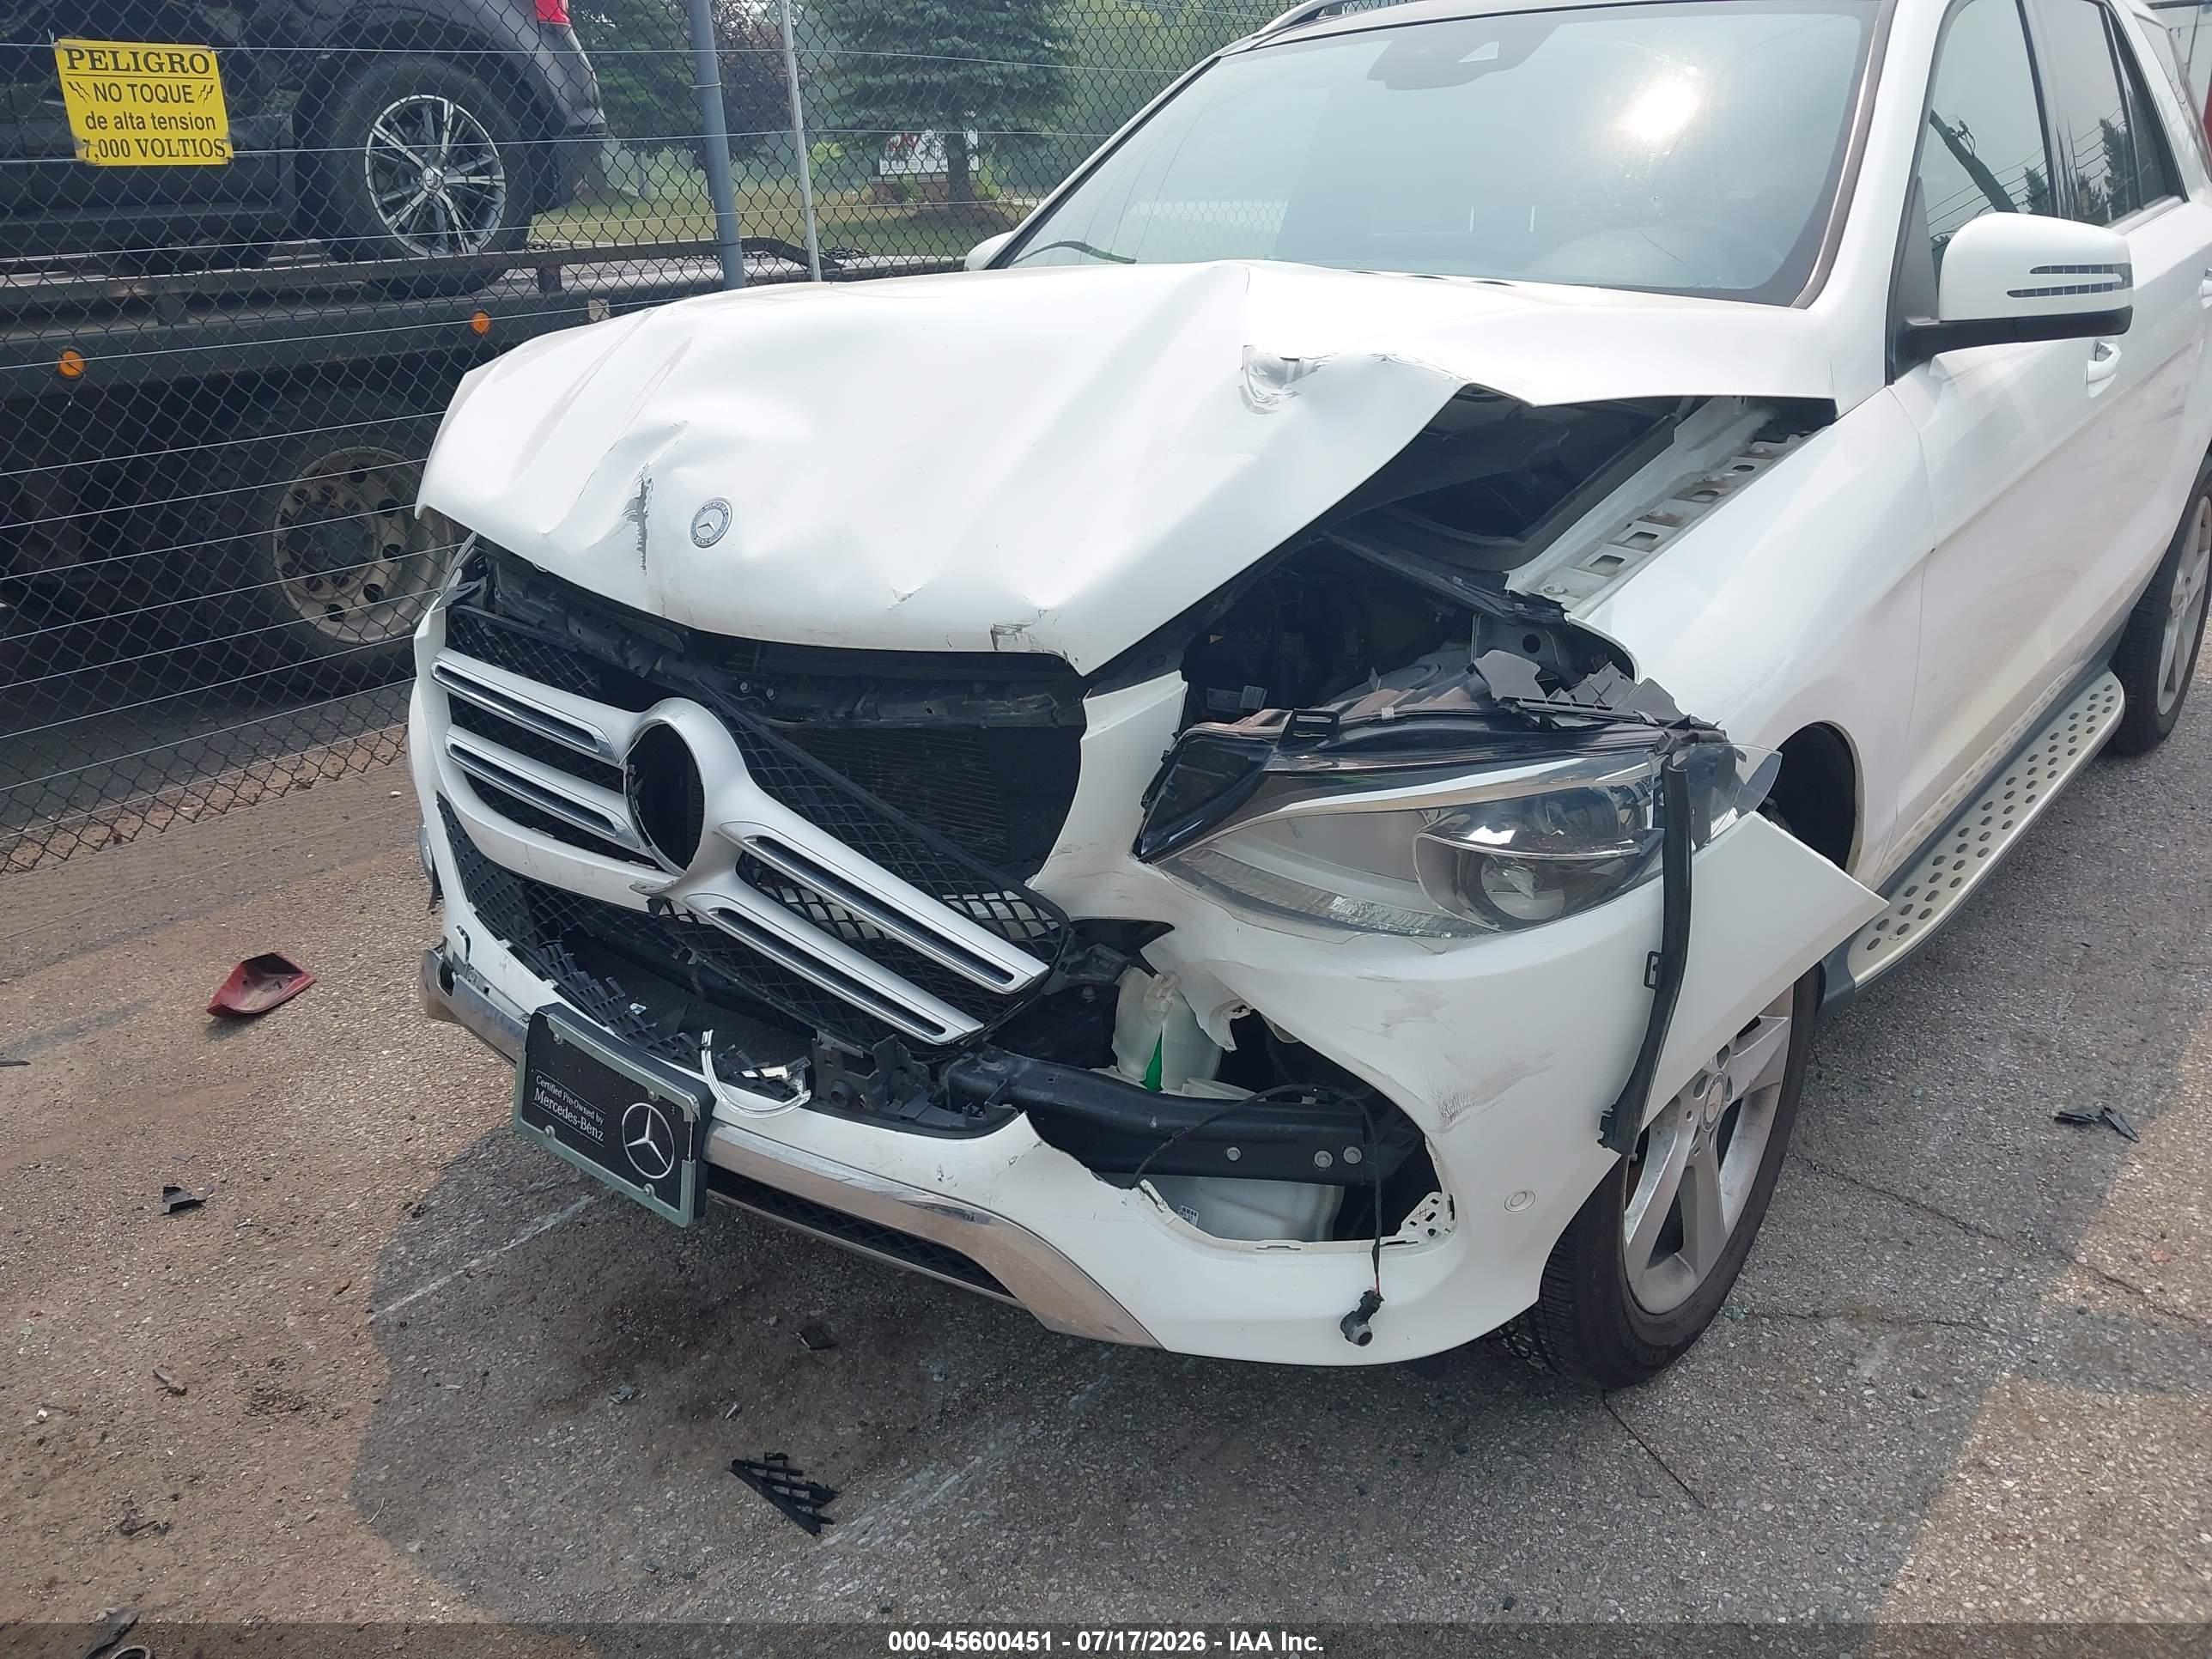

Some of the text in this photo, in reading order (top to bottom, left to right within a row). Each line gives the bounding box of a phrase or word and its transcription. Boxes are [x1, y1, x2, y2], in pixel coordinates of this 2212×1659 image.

[64, 48, 210, 75] PELIGRO
[93, 82, 195, 104] NO TOQUE
[85, 111, 216, 130] de alta tension
[135, 138, 226, 158] VOLTIOS
[536, 1075, 605, 1127] Certified Pre-Owned by
[534, 1087, 604, 1141] Mercedes-Benz
